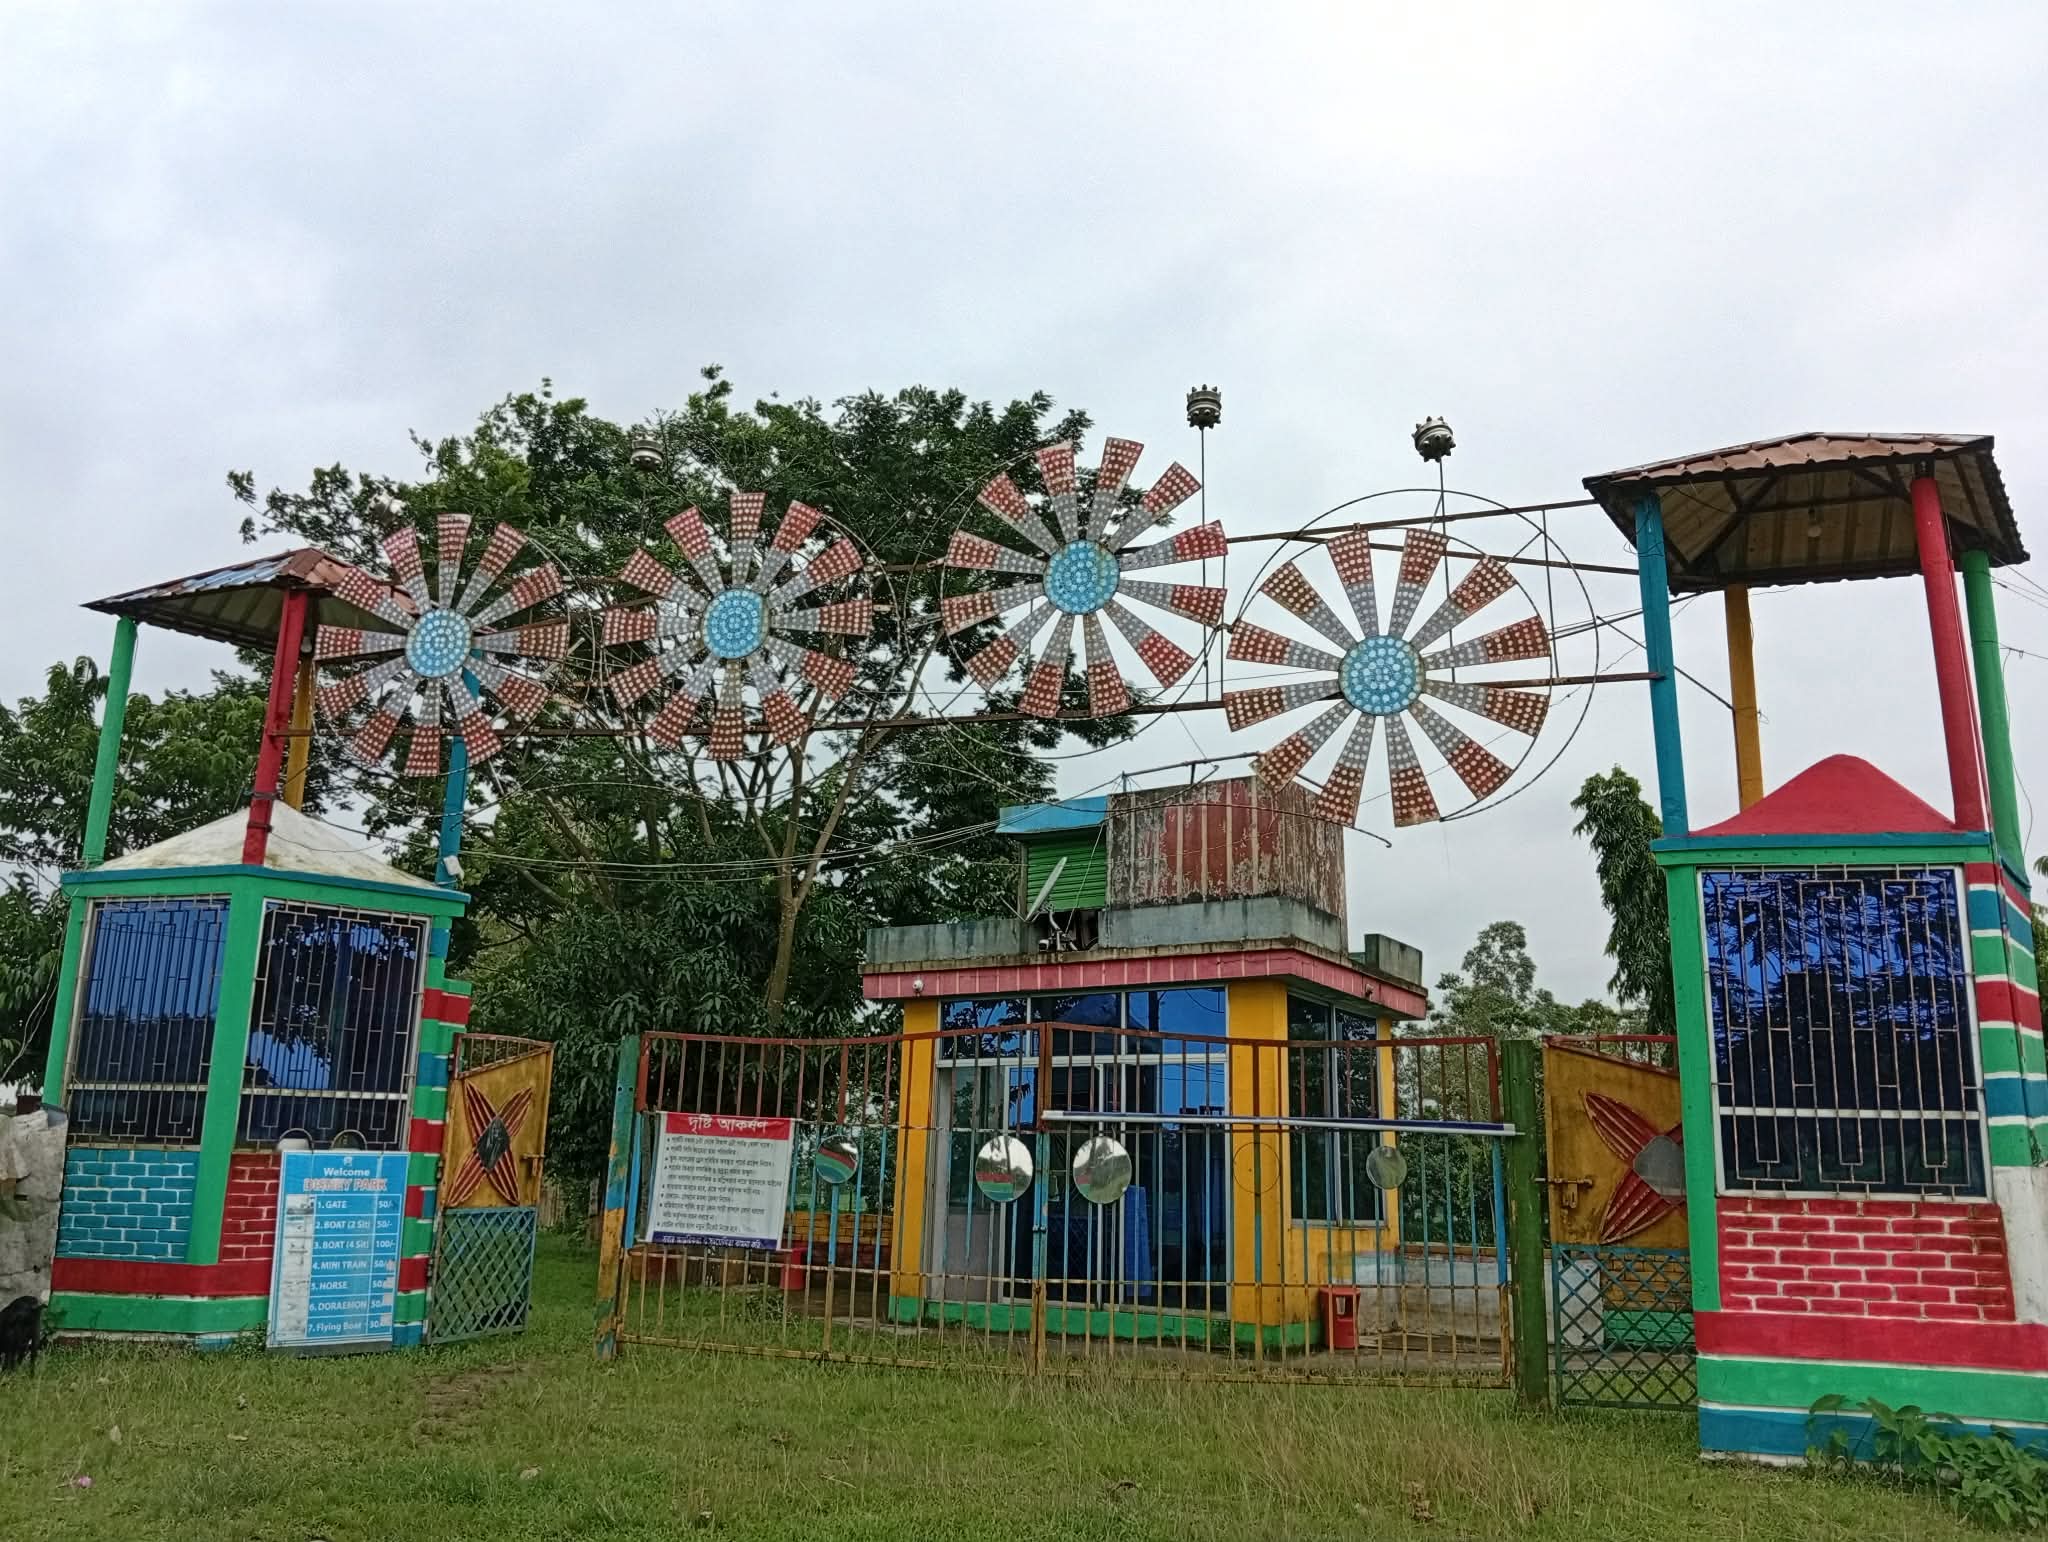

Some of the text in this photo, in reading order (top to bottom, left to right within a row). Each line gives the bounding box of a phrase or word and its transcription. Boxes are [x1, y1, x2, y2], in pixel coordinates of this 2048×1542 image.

[688, 1114, 769, 1135] দৃষ্টি আকর্ষণ
[324, 1167, 371, 1177] Welcome
[353, 1178, 389, 1192] PARK
[325, 1200, 348, 1209] GATE
[378, 1200, 394, 1209] 50/-
[323, 1220, 346, 1229] BOAT
[322, 1240, 345, 1249] BOAT
[375, 1240, 396, 1249] 100/-
[320, 1261, 340, 1270] MINI
[342, 1260, 368, 1269] TRAIN
[319, 1280, 348, 1290] HORSE
[318, 1301, 367, 1311] DORAEMON
[316, 1322, 342, 1333] Flying
